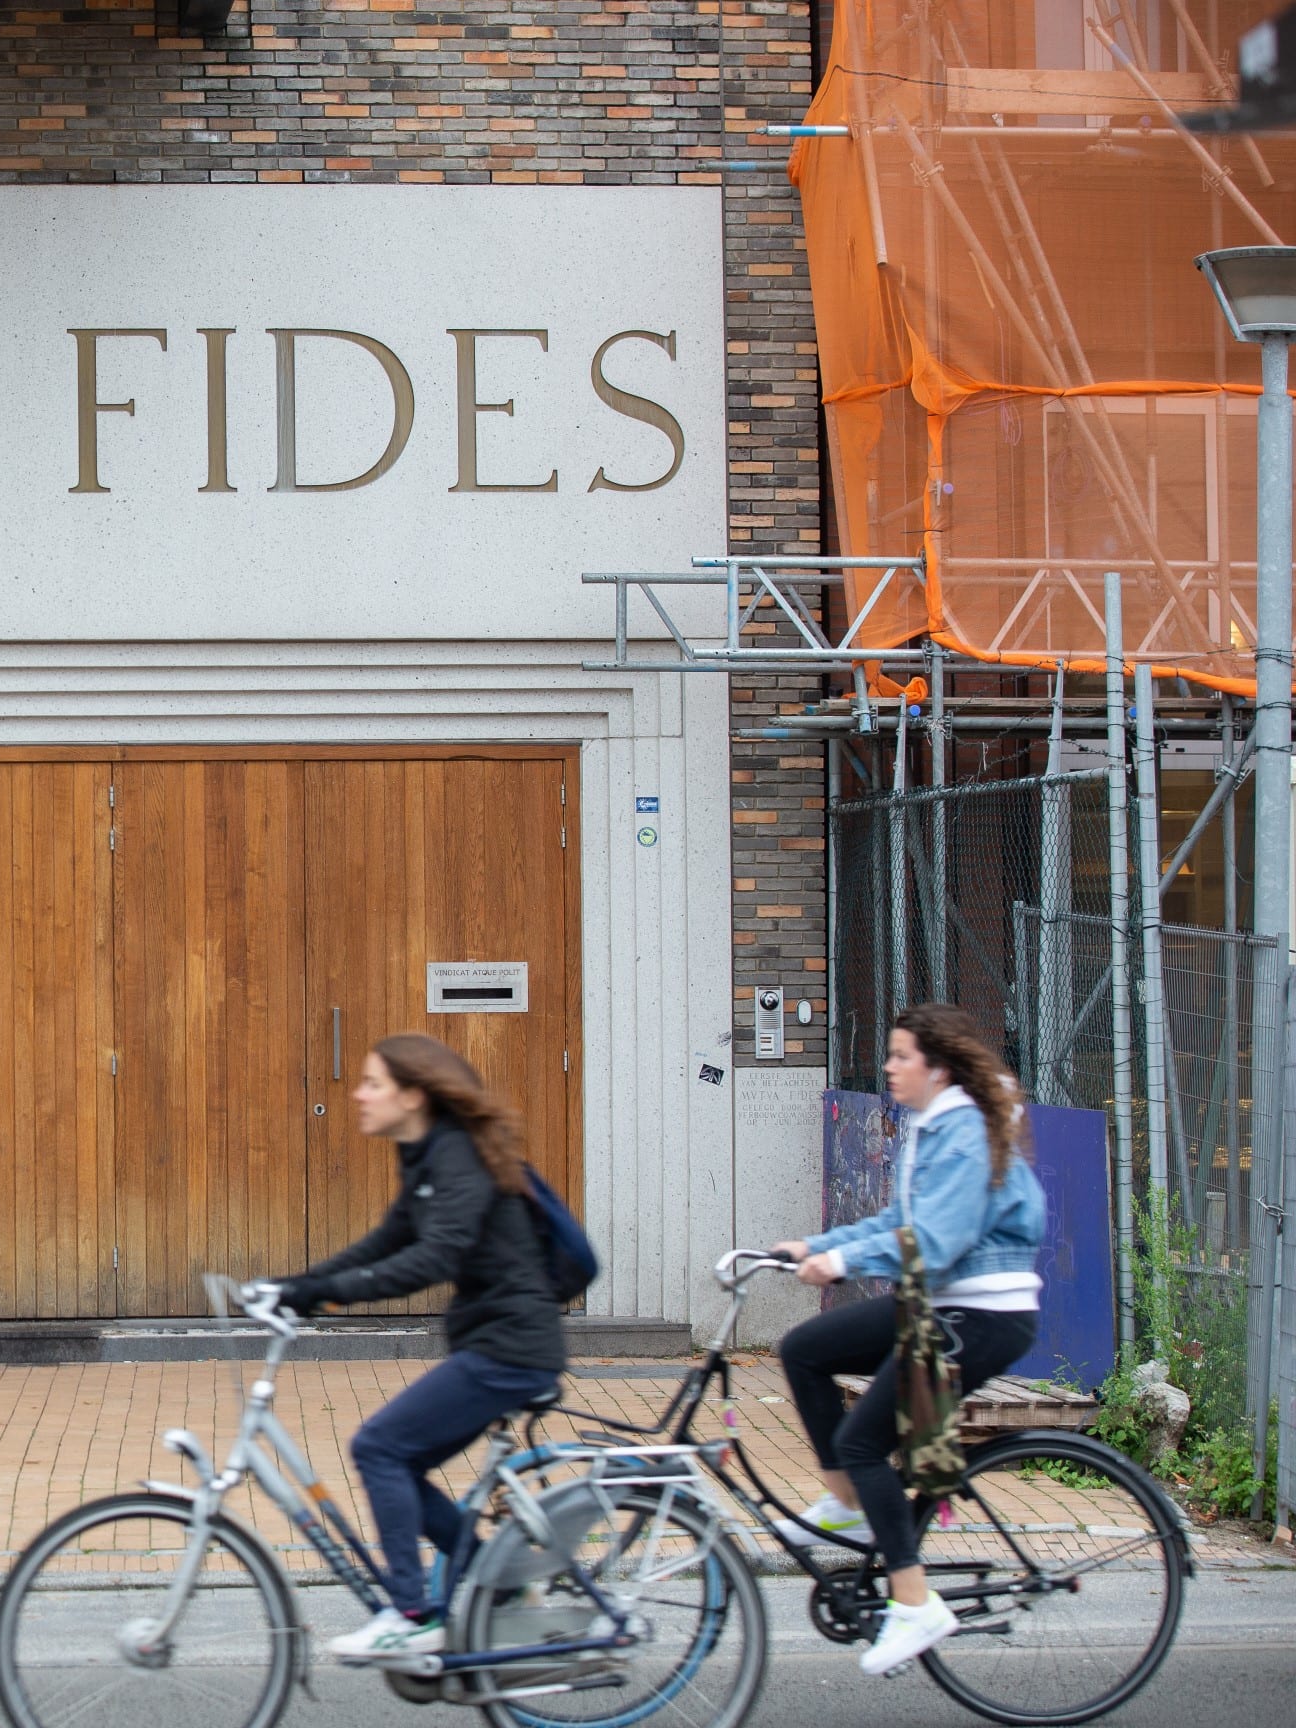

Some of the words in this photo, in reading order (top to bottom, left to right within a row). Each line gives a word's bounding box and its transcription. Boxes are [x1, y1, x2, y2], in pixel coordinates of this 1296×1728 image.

[67, 328, 685, 493] FIDES
[434, 969, 470, 977] VINDICAT
[472, 969, 497, 977] ATQUE
[762, 1079, 779, 1087] HET
[789, 1090, 824, 1100] FIDES
